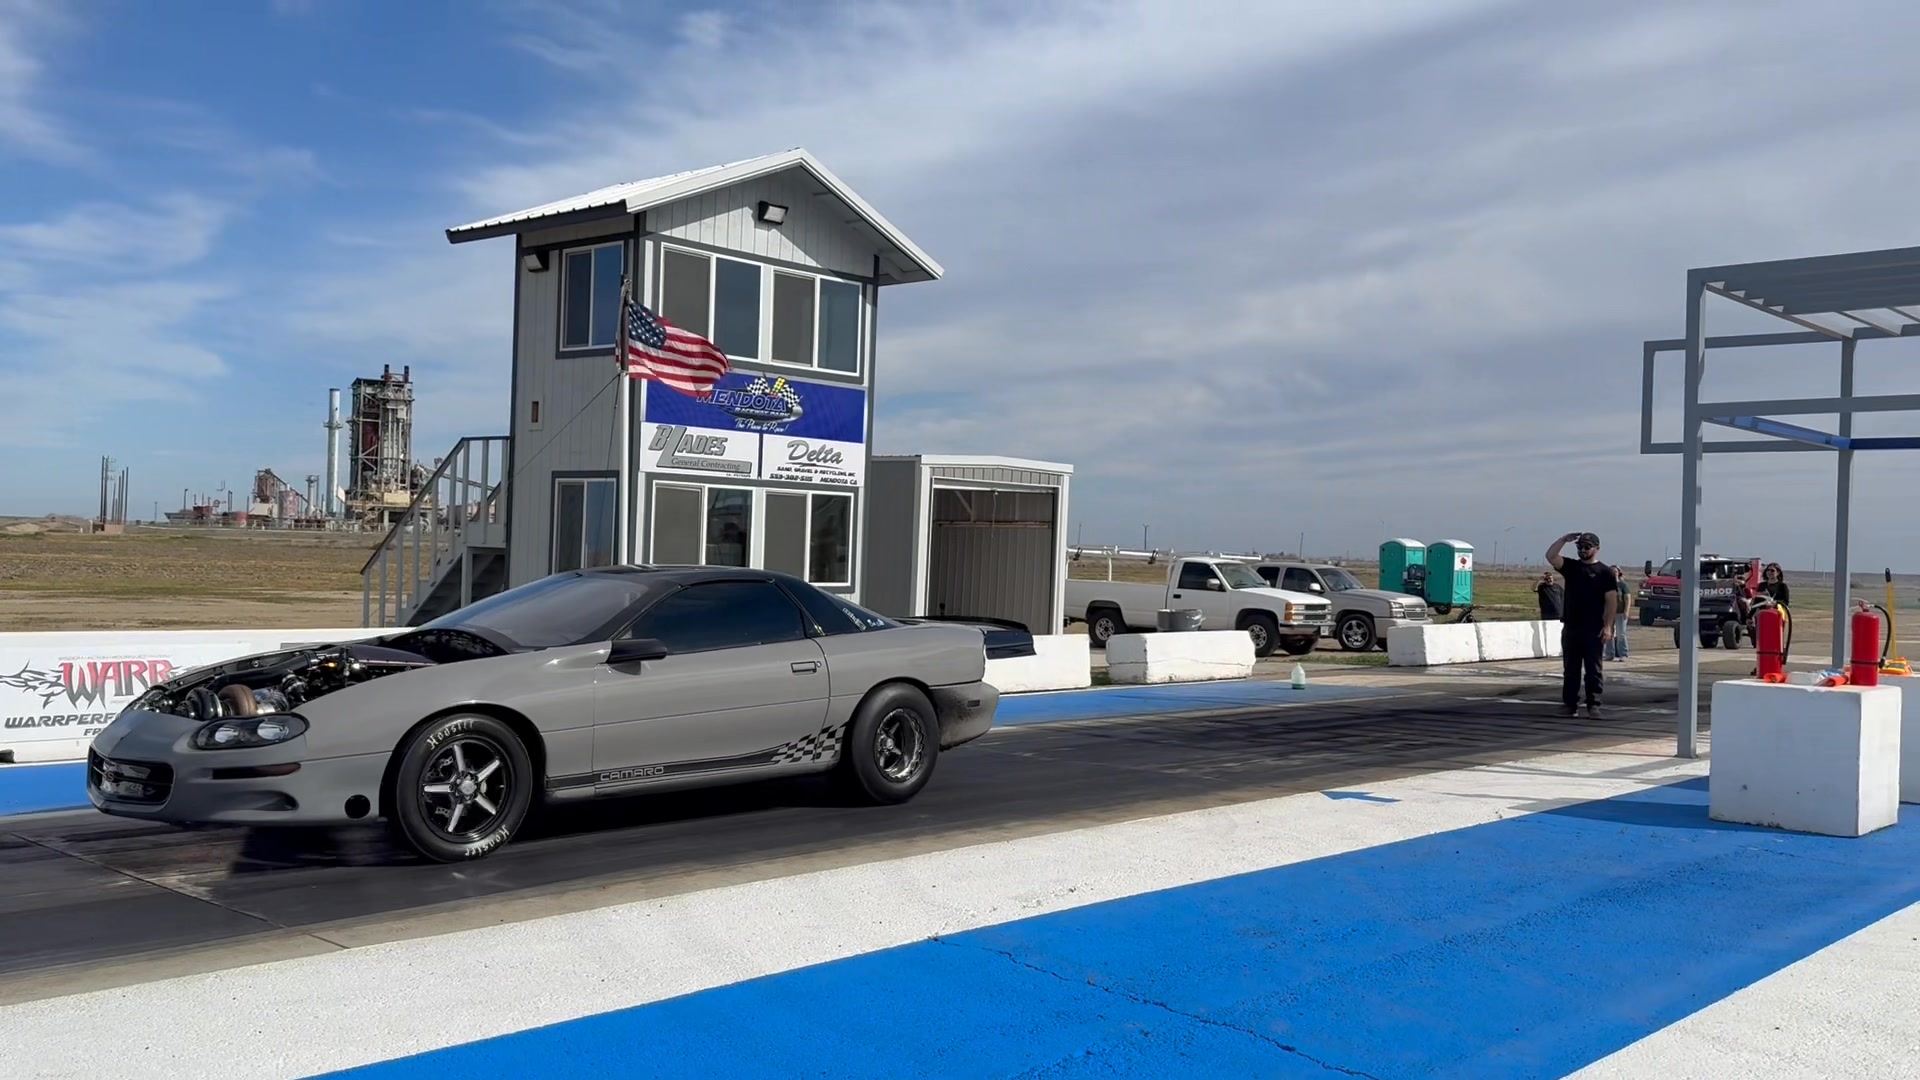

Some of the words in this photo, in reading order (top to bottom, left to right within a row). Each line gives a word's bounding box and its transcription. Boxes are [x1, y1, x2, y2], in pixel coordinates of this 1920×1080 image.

[696, 389, 787, 412] MENDOTA
[648, 425, 729, 463] BLADES
[787, 440, 843, 465] Delta
[671, 458, 700, 467] General
[701, 460, 741, 471] Contracting
[820, 477, 847, 485] MENDOTA
[83, 728, 105, 736] FR
[600, 766, 664, 781] CAMARO
